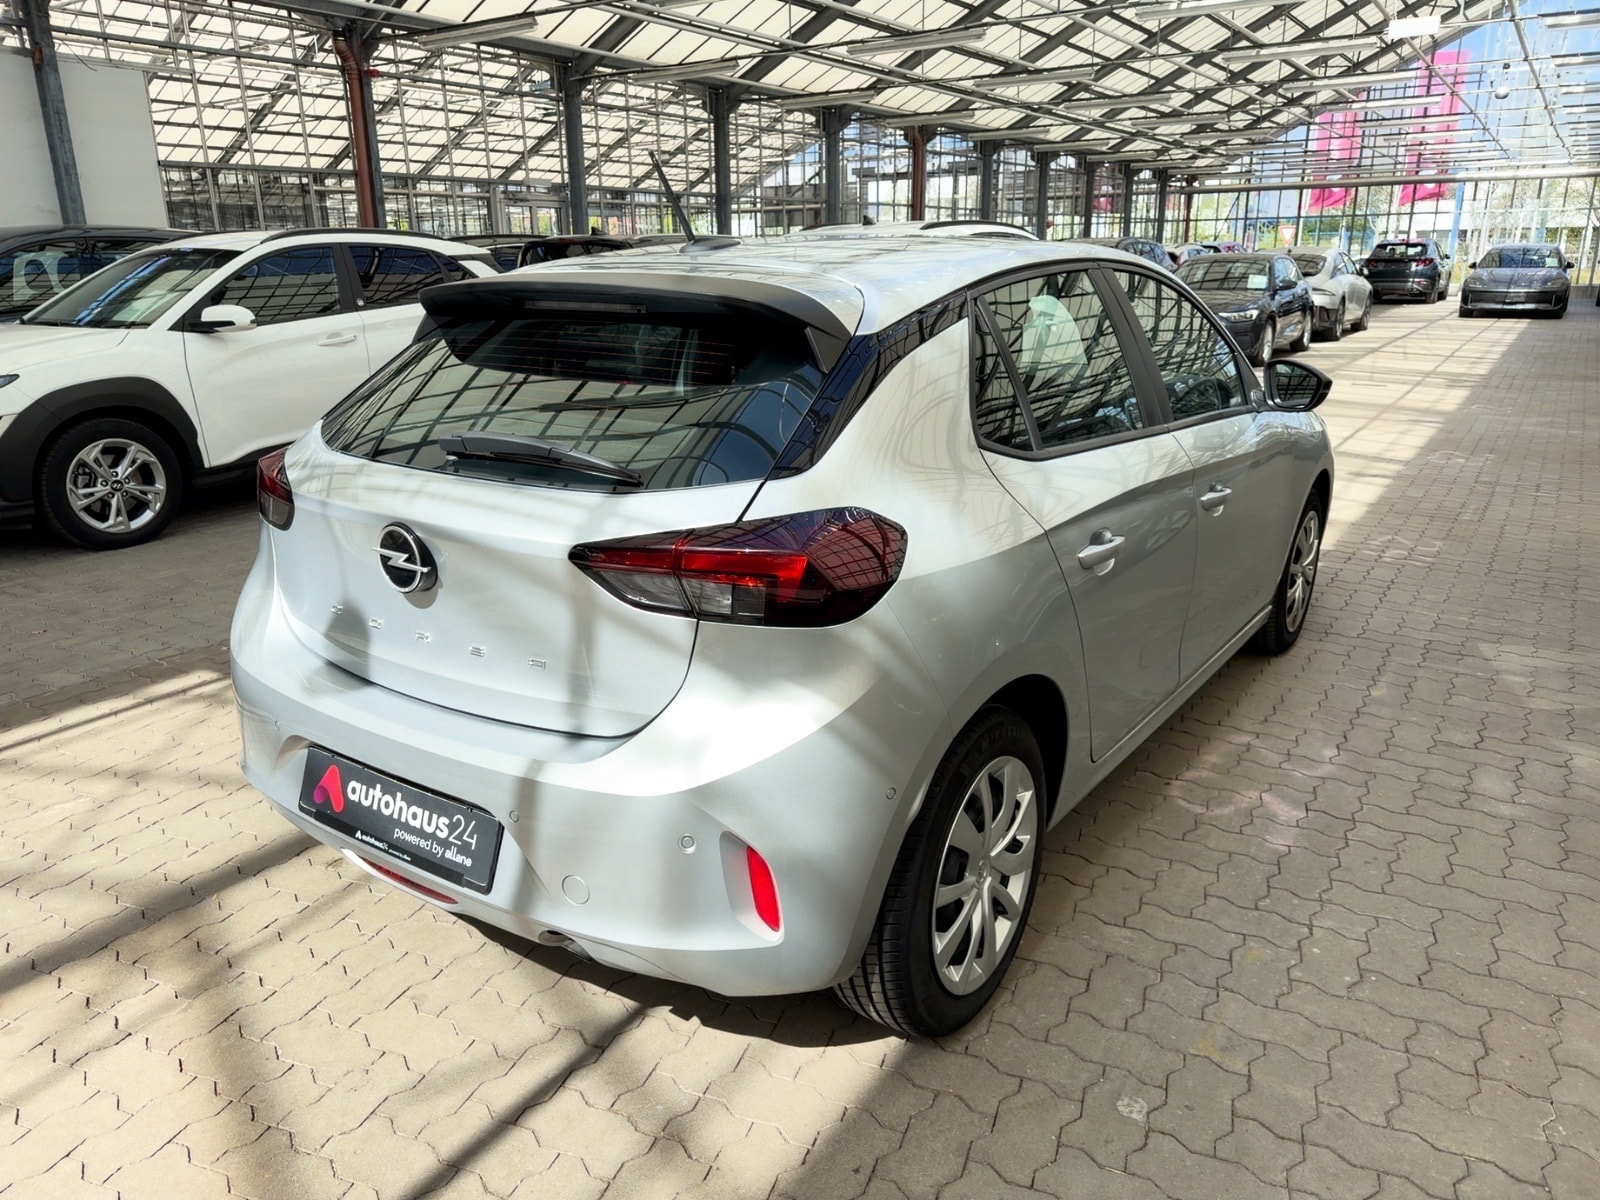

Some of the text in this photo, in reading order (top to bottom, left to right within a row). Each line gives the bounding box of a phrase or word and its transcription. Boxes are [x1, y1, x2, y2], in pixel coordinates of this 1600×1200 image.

[330, 603, 547, 670] CORSA
[347, 780, 477, 850] autohaus24
[394, 828, 431, 851] powered
[432, 841, 444, 858] by
[445, 845, 472, 867] allane
